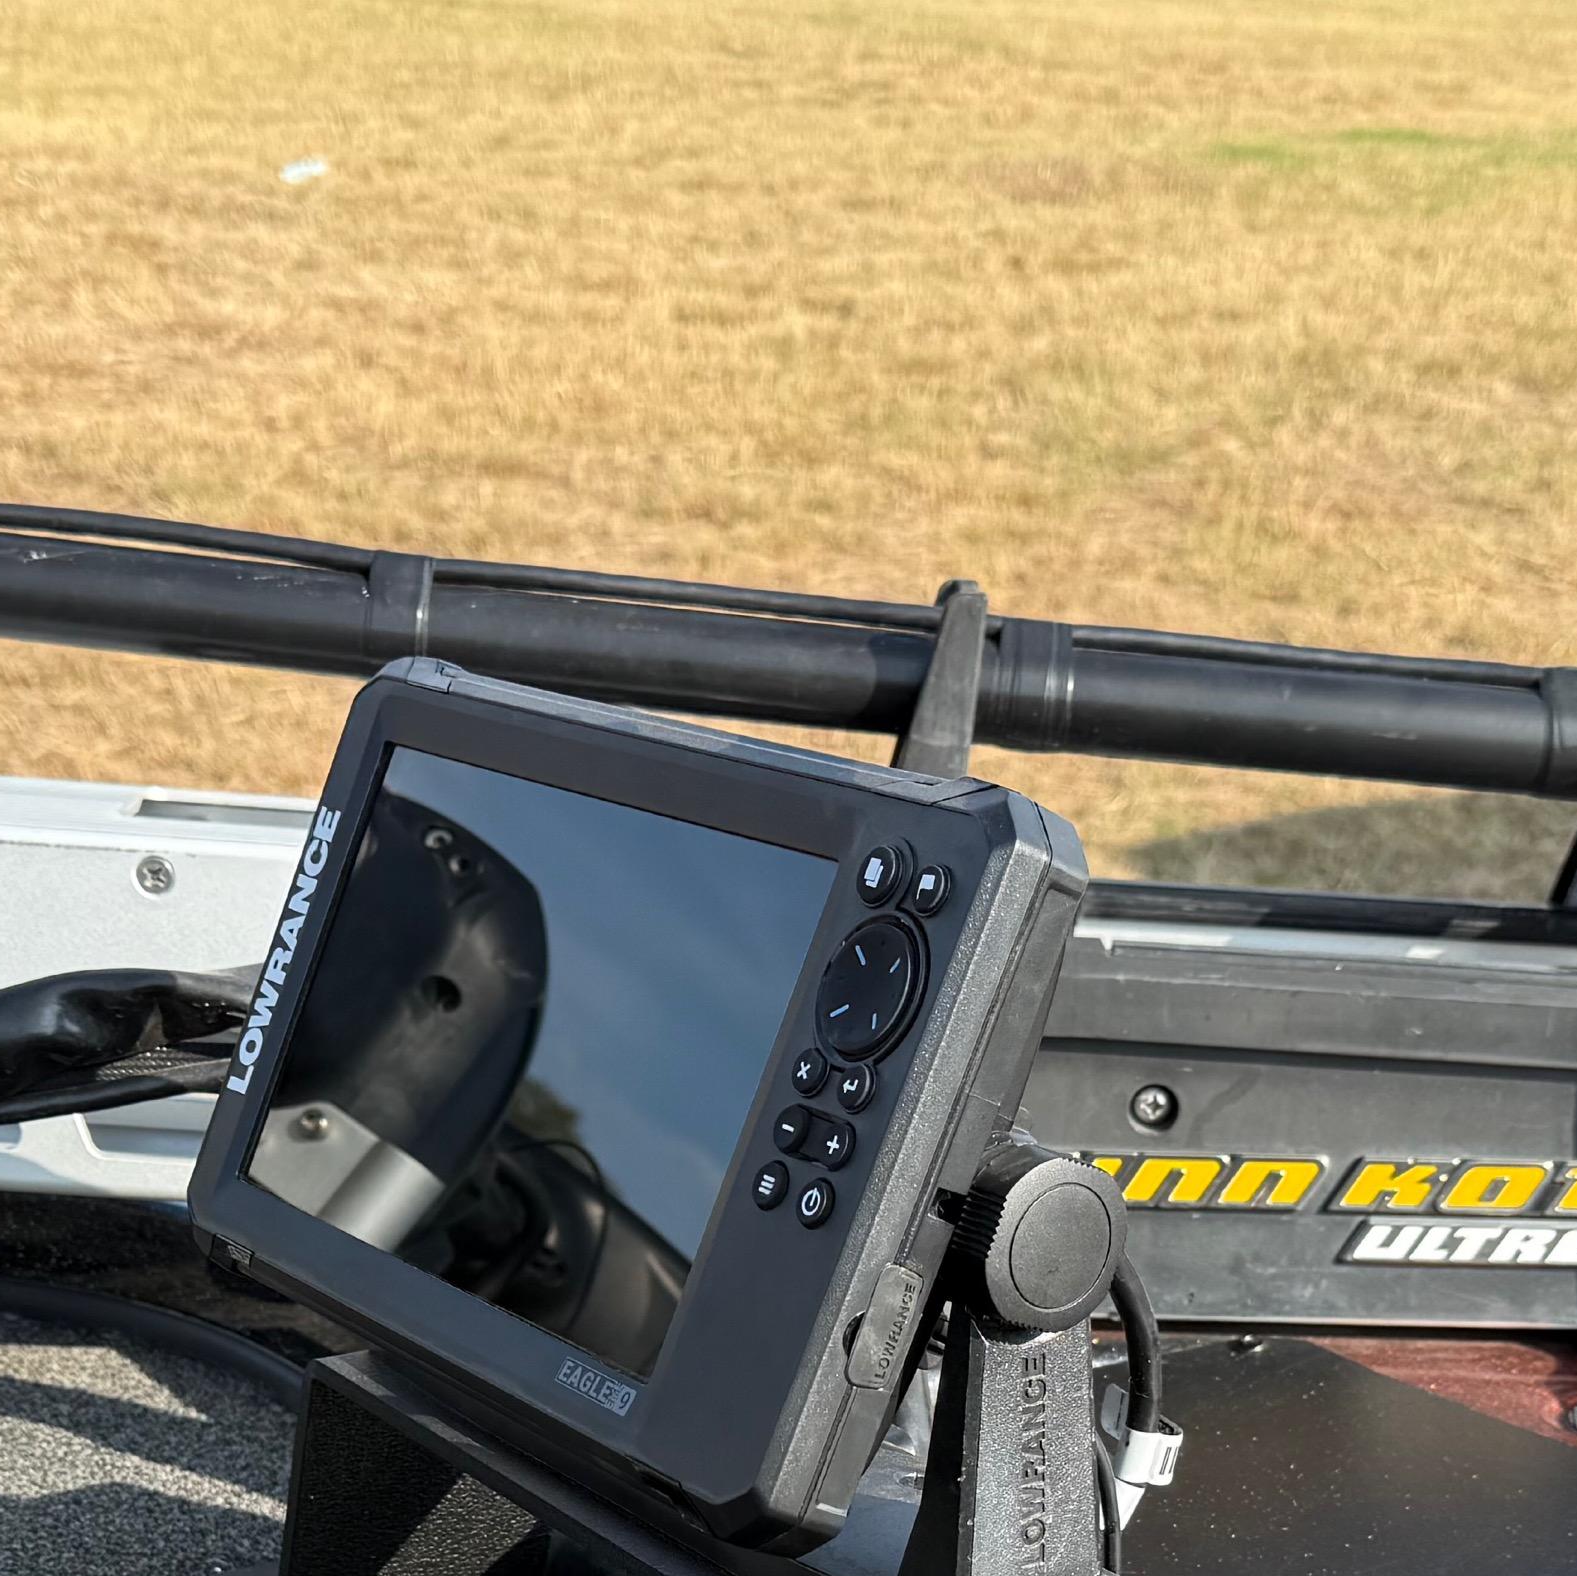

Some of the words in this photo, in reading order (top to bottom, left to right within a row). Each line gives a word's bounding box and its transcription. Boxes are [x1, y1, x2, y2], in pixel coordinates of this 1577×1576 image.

[227, 806, 342, 1095] LOWRANCE
[558, 1360, 615, 1403] EAGLE
[874, 1283, 916, 1379] LOWRANCE
[1021, 1352, 1046, 1570] LOWRANCE
